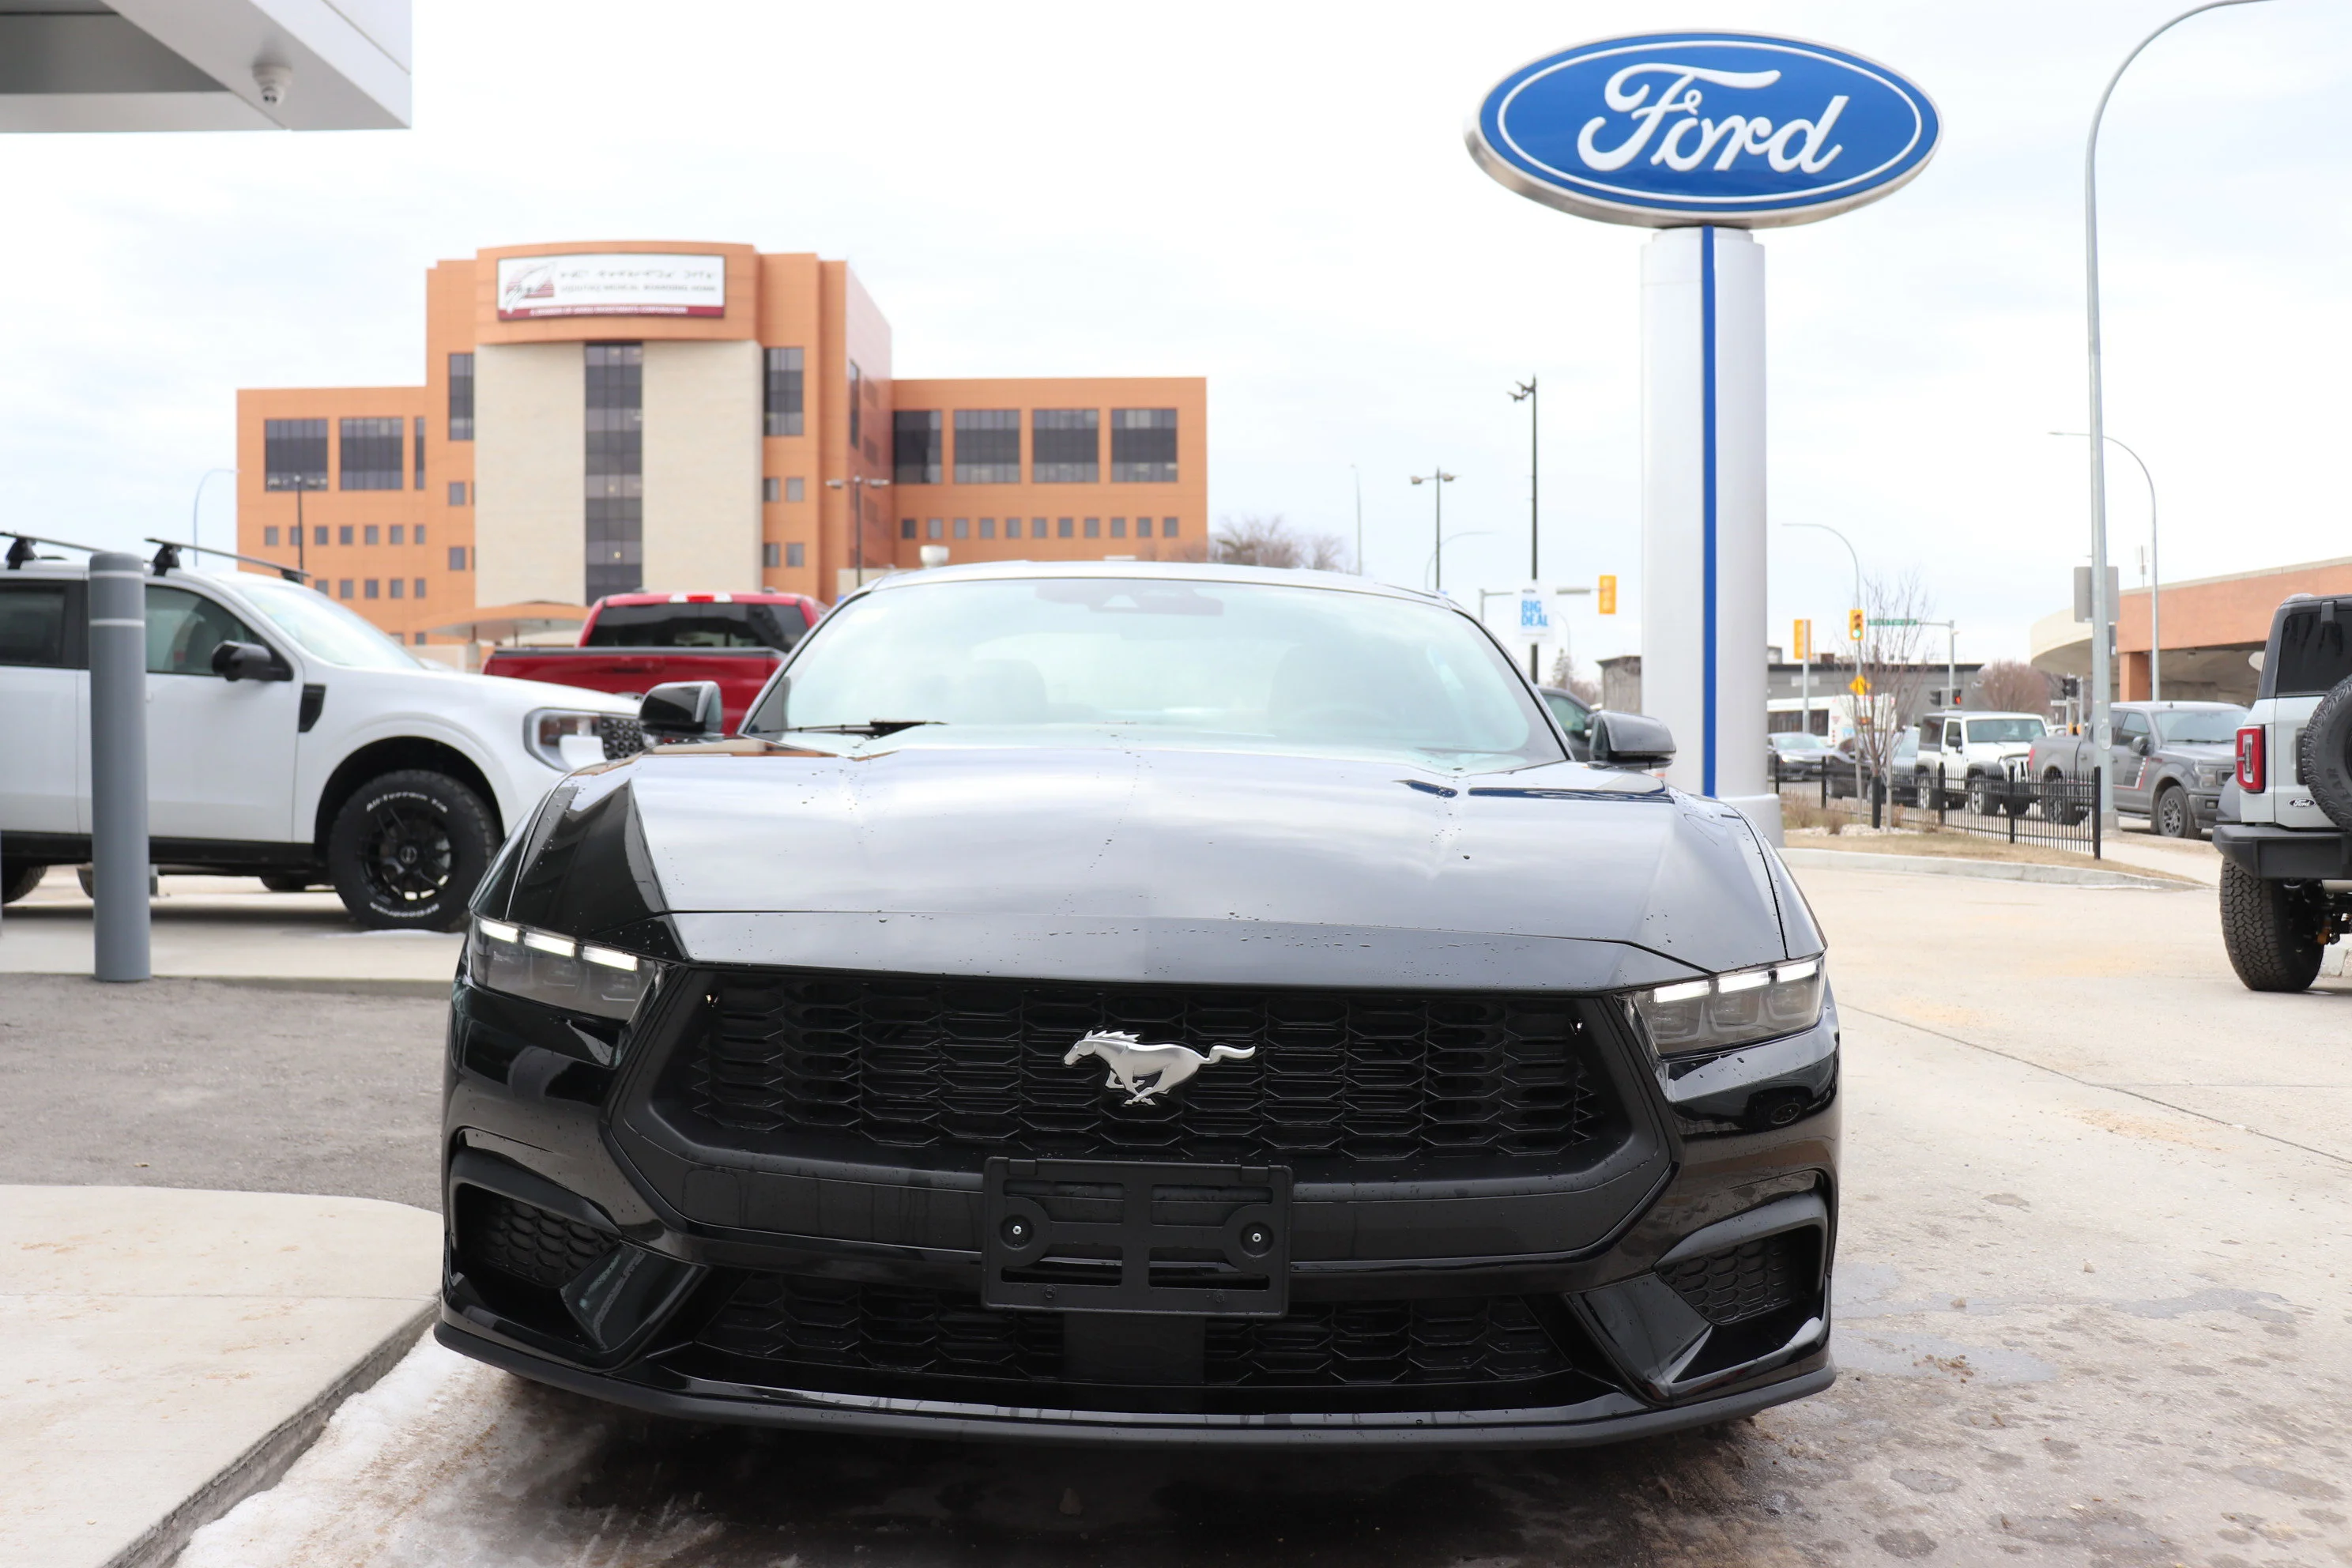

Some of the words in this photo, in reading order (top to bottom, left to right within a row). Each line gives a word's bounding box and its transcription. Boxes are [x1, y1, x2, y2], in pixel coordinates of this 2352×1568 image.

[1577, 62, 1849, 173] Ford
[1521, 601, 1541, 612] BIG
[1521, 614, 1548, 627] DEAL
[2292, 798, 2312, 807] Ford
